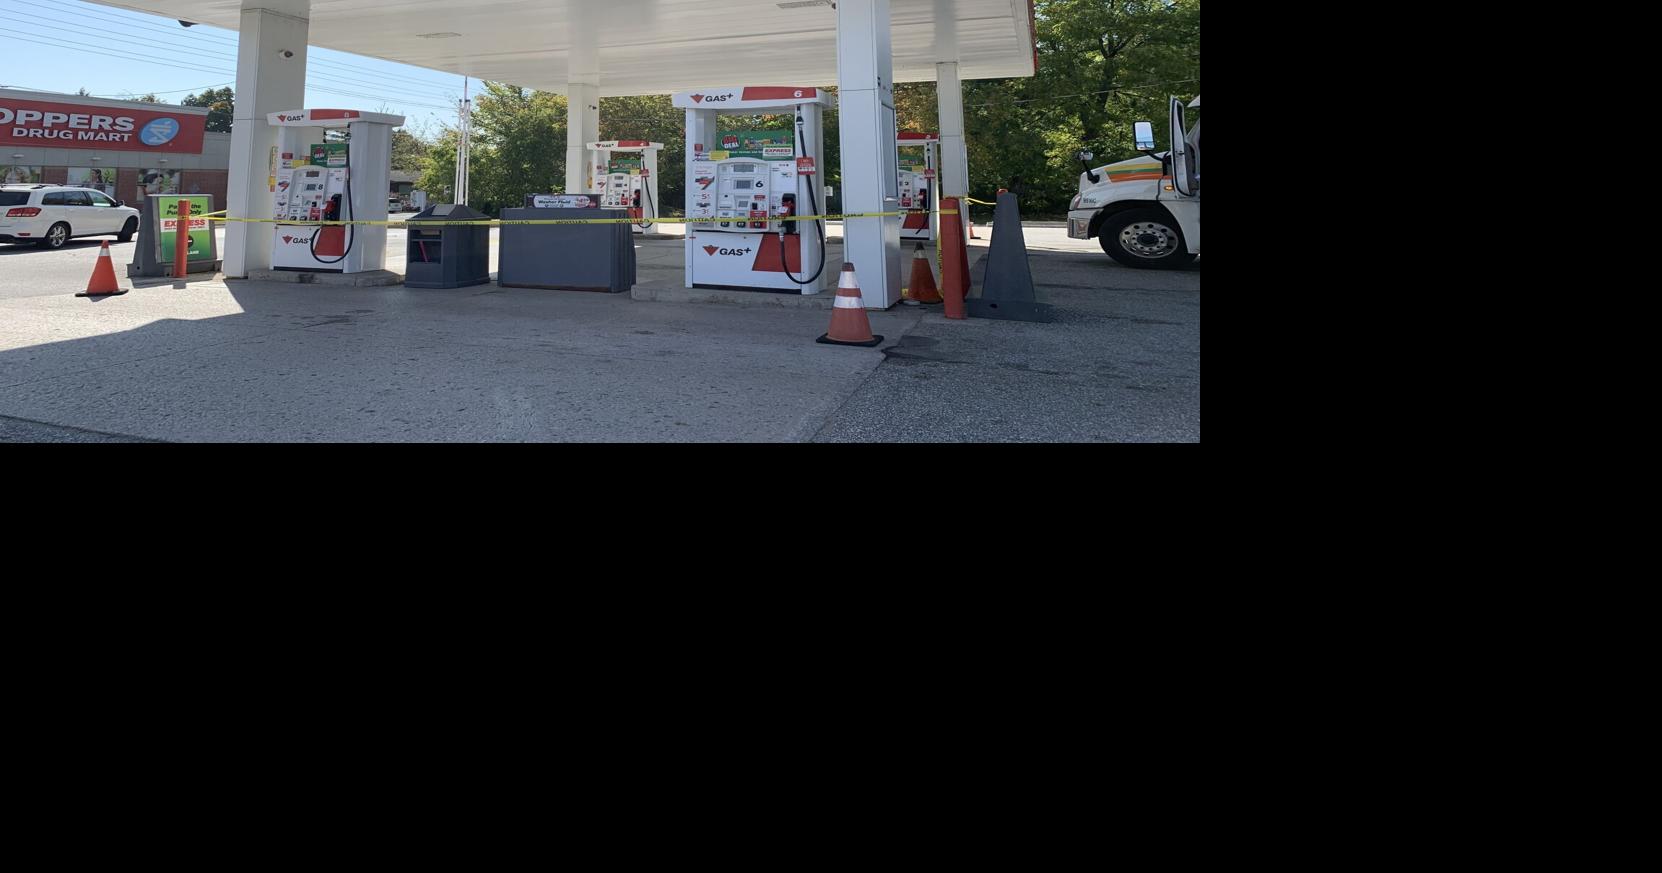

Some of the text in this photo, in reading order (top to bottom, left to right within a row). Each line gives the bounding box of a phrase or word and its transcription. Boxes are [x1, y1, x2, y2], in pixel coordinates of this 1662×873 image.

[12, 127, 132, 142] DRUG MART
[755, 180, 764, 188] 6
[164, 219, 206, 228] EXESS
